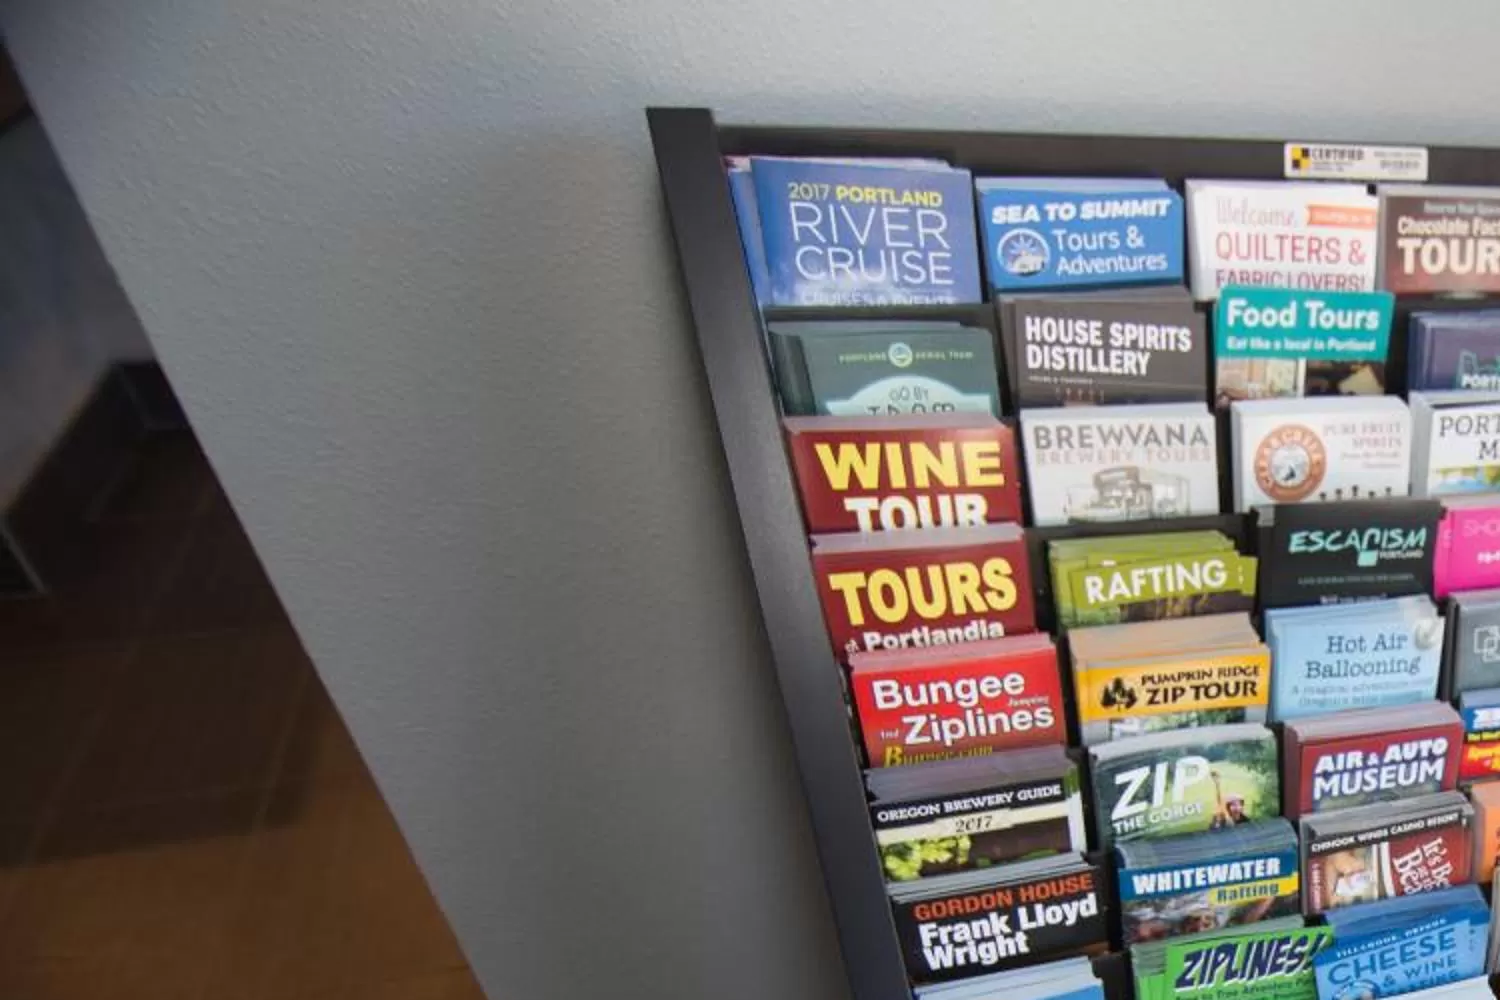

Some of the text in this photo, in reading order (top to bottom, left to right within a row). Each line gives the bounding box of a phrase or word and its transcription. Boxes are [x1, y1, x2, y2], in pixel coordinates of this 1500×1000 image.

[787, 183, 943, 208] 2017 PORTLAND
[991, 199, 1170, 225] SEA TO SUMMIT
[788, 202, 949, 250] RIVER
[1051, 226, 1145, 252] Tours &
[1397, 215, 1469, 238] Chocolate
[795, 245, 955, 286] CRUISE
[1056, 253, 1168, 276] Adventures
[1215, 233, 1367, 266] QUILTERS &
[1226, 298, 1380, 331] Food Tours
[1025, 316, 1192, 353] HOUSE SPIRITS
[1025, 345, 1152, 376] DISTILLERY
[1033, 423, 1210, 451] BREWVANA
[815, 440, 1005, 491] WINE
[844, 493, 990, 533] TOUR
[828, 557, 1018, 628] TOURS
[1085, 560, 1229, 605] RAFTING
[863, 619, 1005, 653] Portlandia
[1326, 631, 1409, 655] Hot Air
[1140, 664, 1261, 686] PUMPKIN RIDGE
[1305, 655, 1421, 681] Ballooning
[872, 671, 1026, 711] Bungee
[1145, 679, 1258, 706] ZIP TOUR
[903, 703, 1055, 747] Ziplines
[1313, 753, 1363, 775] AIR
[1366, 752, 1379, 766] &
[1383, 736, 1449, 761] AUTO
[1111, 755, 1211, 821] ZIP
[1312, 759, 1447, 800] MUSEUM
[876, 784, 1061, 823] OREGON BREWERY GUIDE
[953, 815, 993, 835] 2017
[1113, 814, 1146, 835] THE
[1311, 812, 1460, 853] CHINOOK WINDS CASINO RESORT
[1132, 856, 1281, 896] WHITEWATER
[1216, 881, 1280, 903] Rafting
[914, 875, 1094, 921] GORDON HOUSE
[918, 894, 1098, 949] Frank Lloyd
[923, 937, 1031, 972] Wright
[1174, 932, 1329, 993] ZIPLINES!
[1327, 927, 1457, 986] CHEESE
[1382, 952, 1458, 989] & WINE
